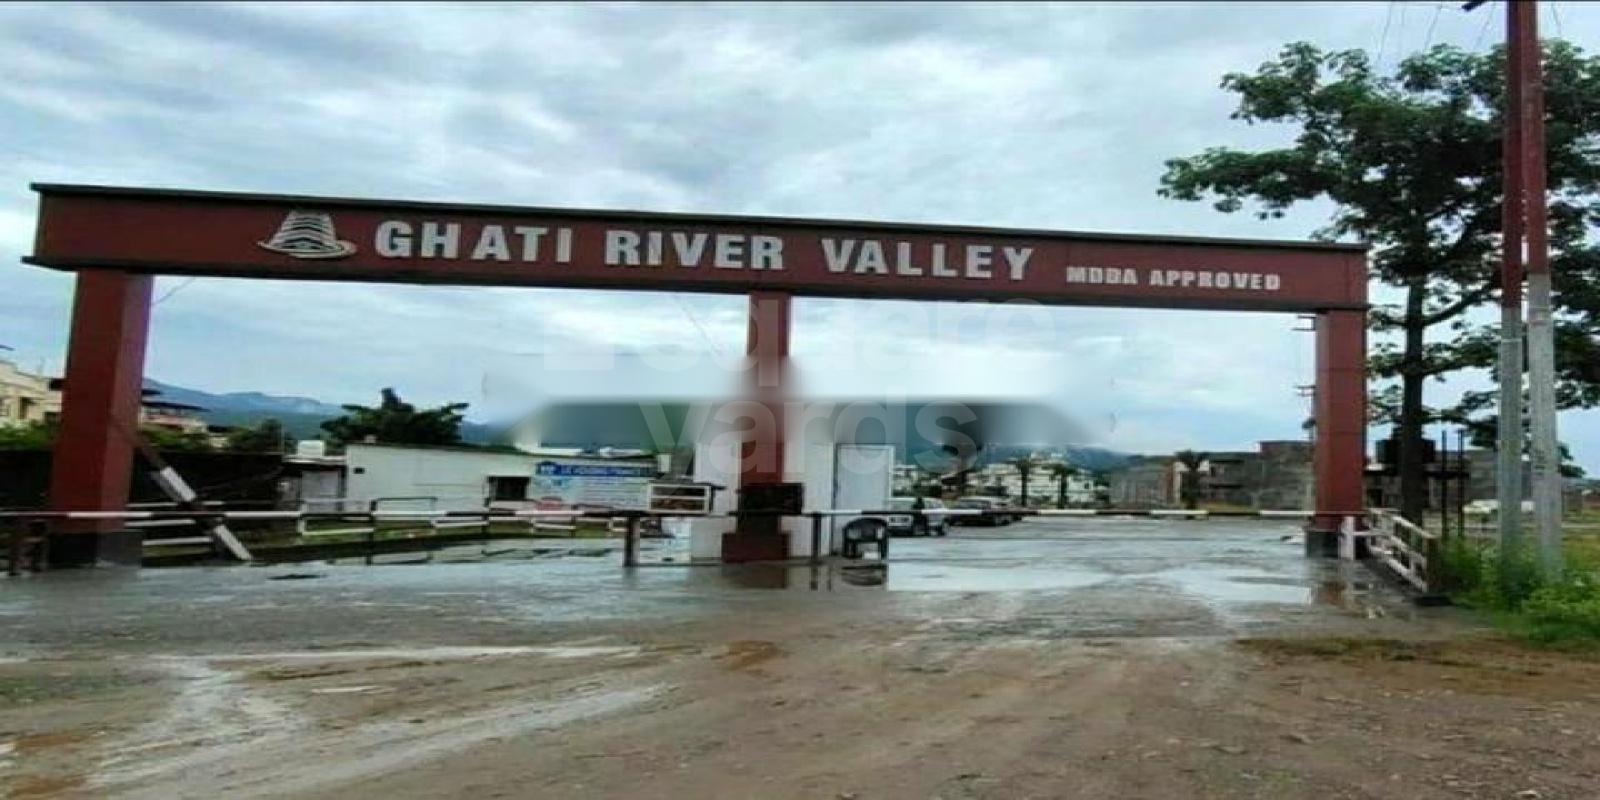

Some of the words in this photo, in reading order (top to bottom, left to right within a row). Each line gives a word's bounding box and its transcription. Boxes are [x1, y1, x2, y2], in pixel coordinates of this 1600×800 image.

[374, 219, 572, 263] GHATI
[604, 228, 784, 271] RIVER
[820, 238, 1034, 281] VALLEY
[1149, 269, 1281, 290] APPROVED
